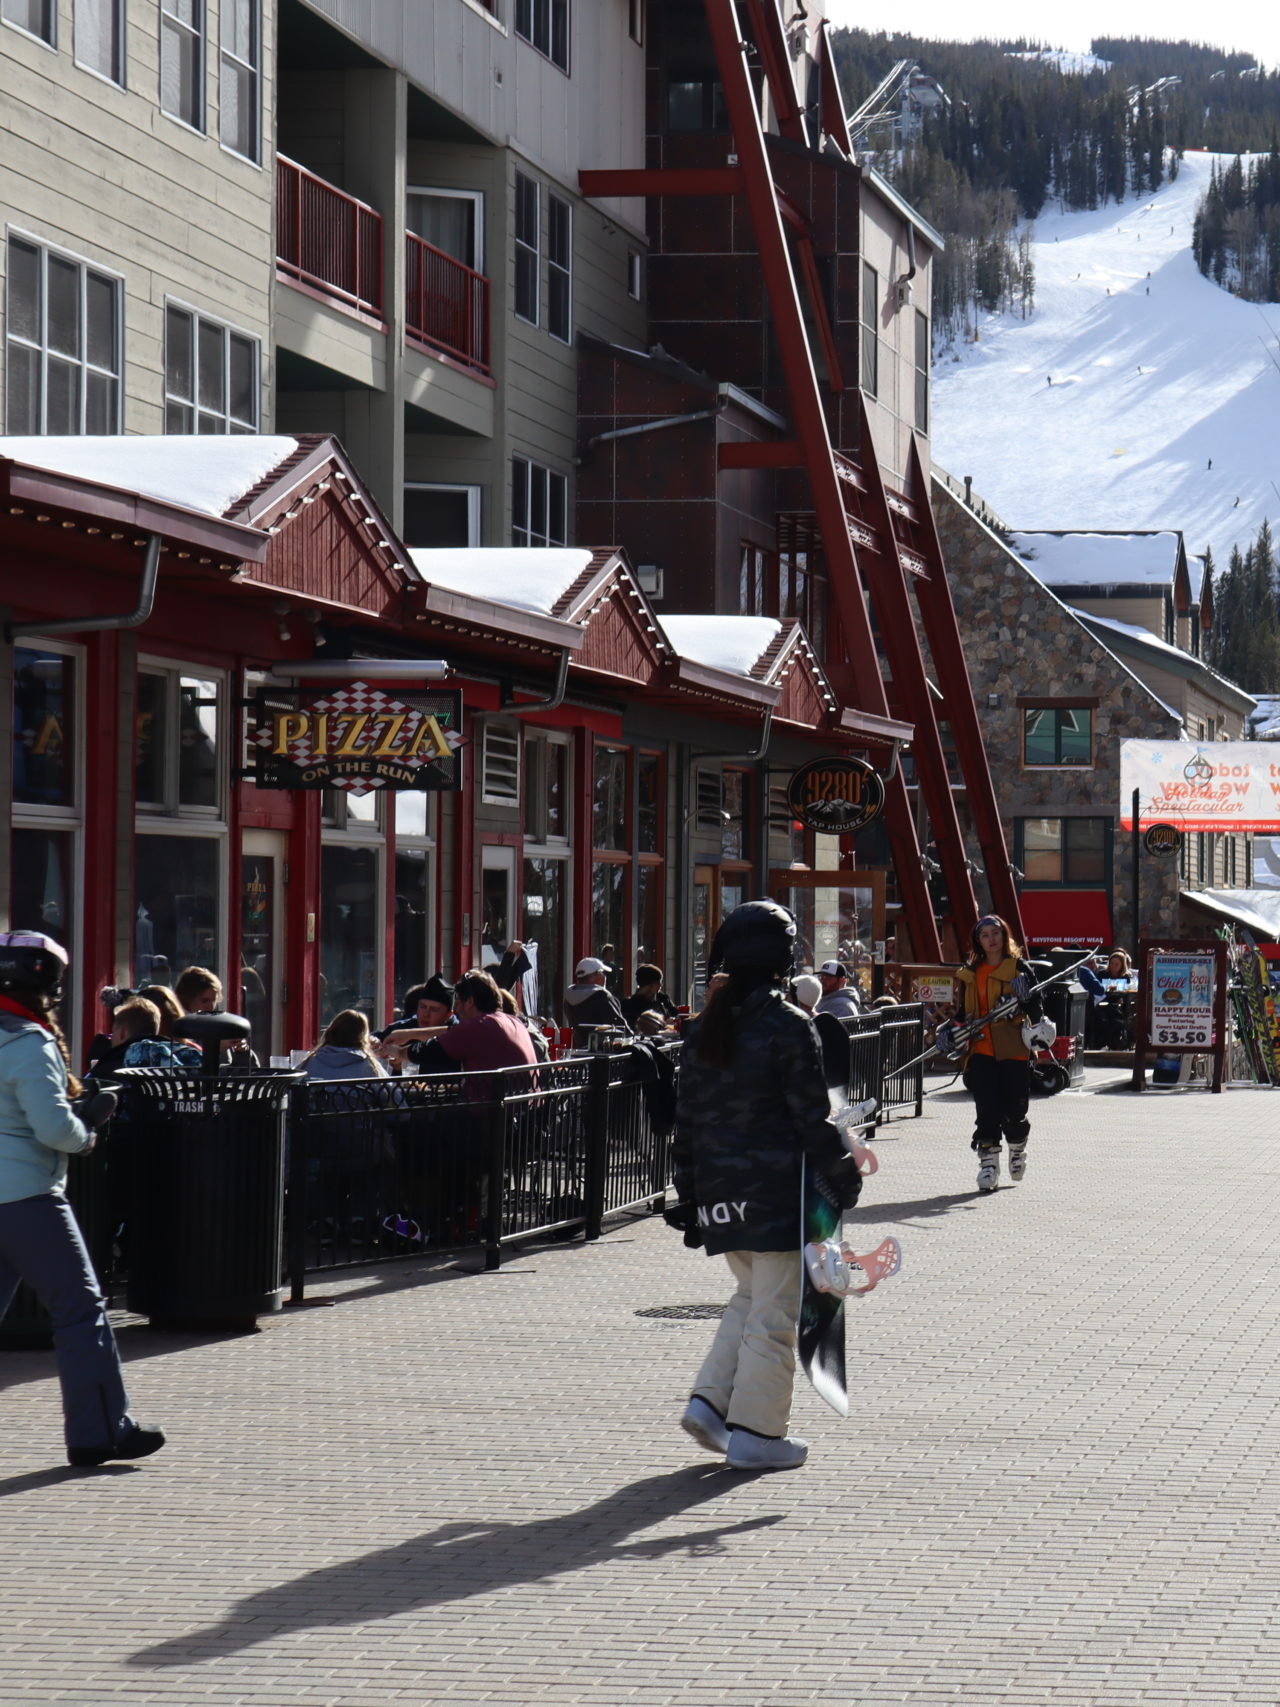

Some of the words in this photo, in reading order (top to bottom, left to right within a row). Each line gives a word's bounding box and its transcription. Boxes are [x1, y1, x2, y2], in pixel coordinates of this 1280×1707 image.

[272, 712, 453, 757] PIZZA
[302, 764, 330, 782] ON
[334, 762, 371, 774] THE
[376, 764, 416, 784] RUN
[1150, 796, 1245, 814] Spectacular
[807, 817, 825, 828] TAP
[827, 818, 862, 831] HOUSE
[1157, 976, 1186, 989] Chill
[1159, 1030, 1206, 1044] $3.50
[174, 1102, 204, 1113] TRASH
